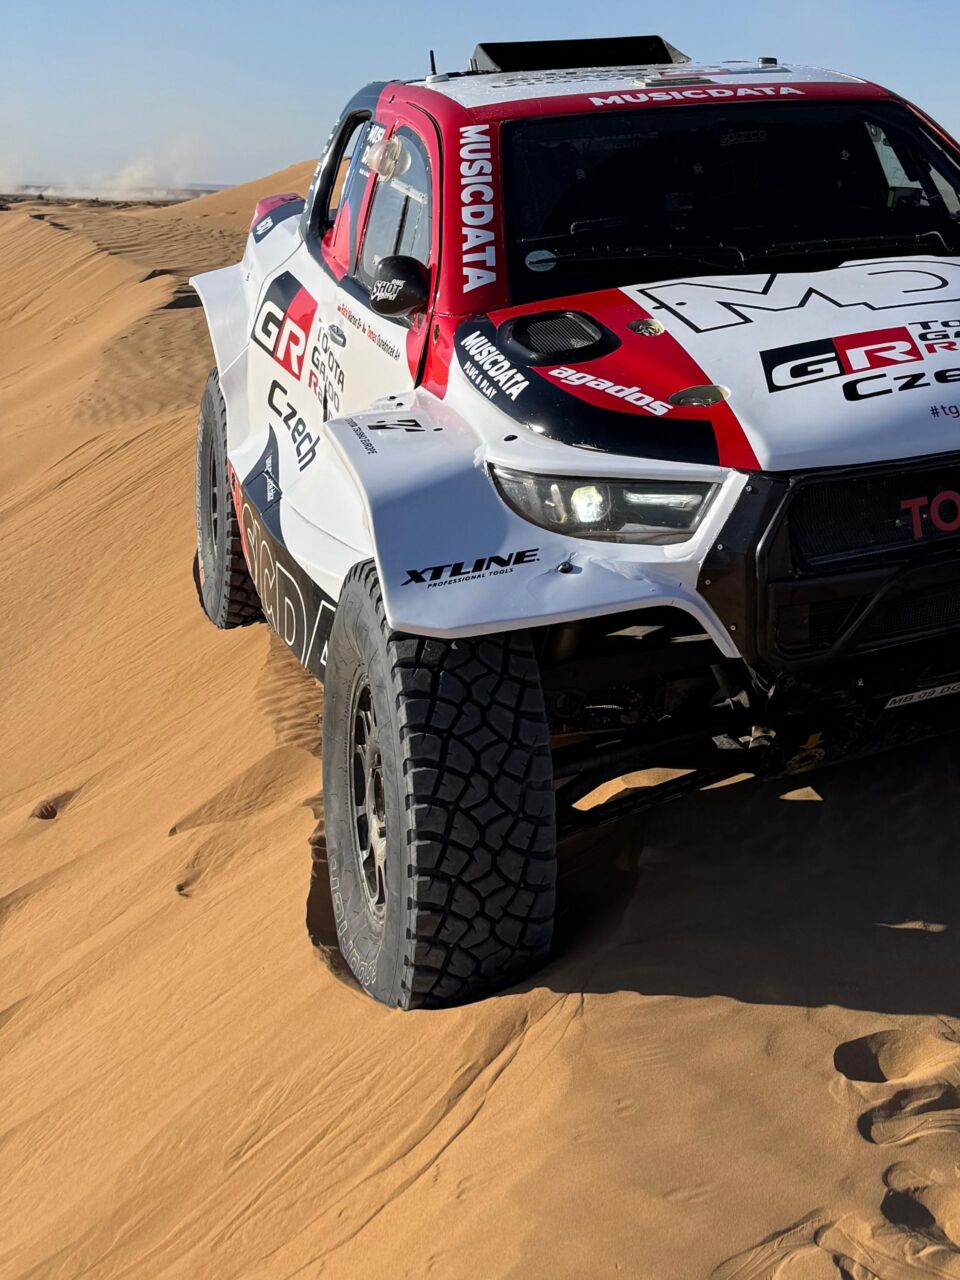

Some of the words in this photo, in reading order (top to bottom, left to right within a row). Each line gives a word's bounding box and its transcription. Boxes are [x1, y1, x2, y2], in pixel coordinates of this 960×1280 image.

[589, 86, 805, 107] MUSICDATA
[459, 124, 497, 294] MUSICDATA
[371, 280, 403, 300] SHOT
[254, 300, 306, 377] GR
[460, 330, 530, 401] MUSICDATA
[463, 360, 477, 382] PLUG
[479, 380, 497, 400] PLAY
[771, 340, 918, 388] GR
[548, 366, 674, 416] agados
[268, 379, 320, 472] Czech
[427, 573, 486, 589] PROFESSIONAL
[489, 568, 514, 577] TOOLS
